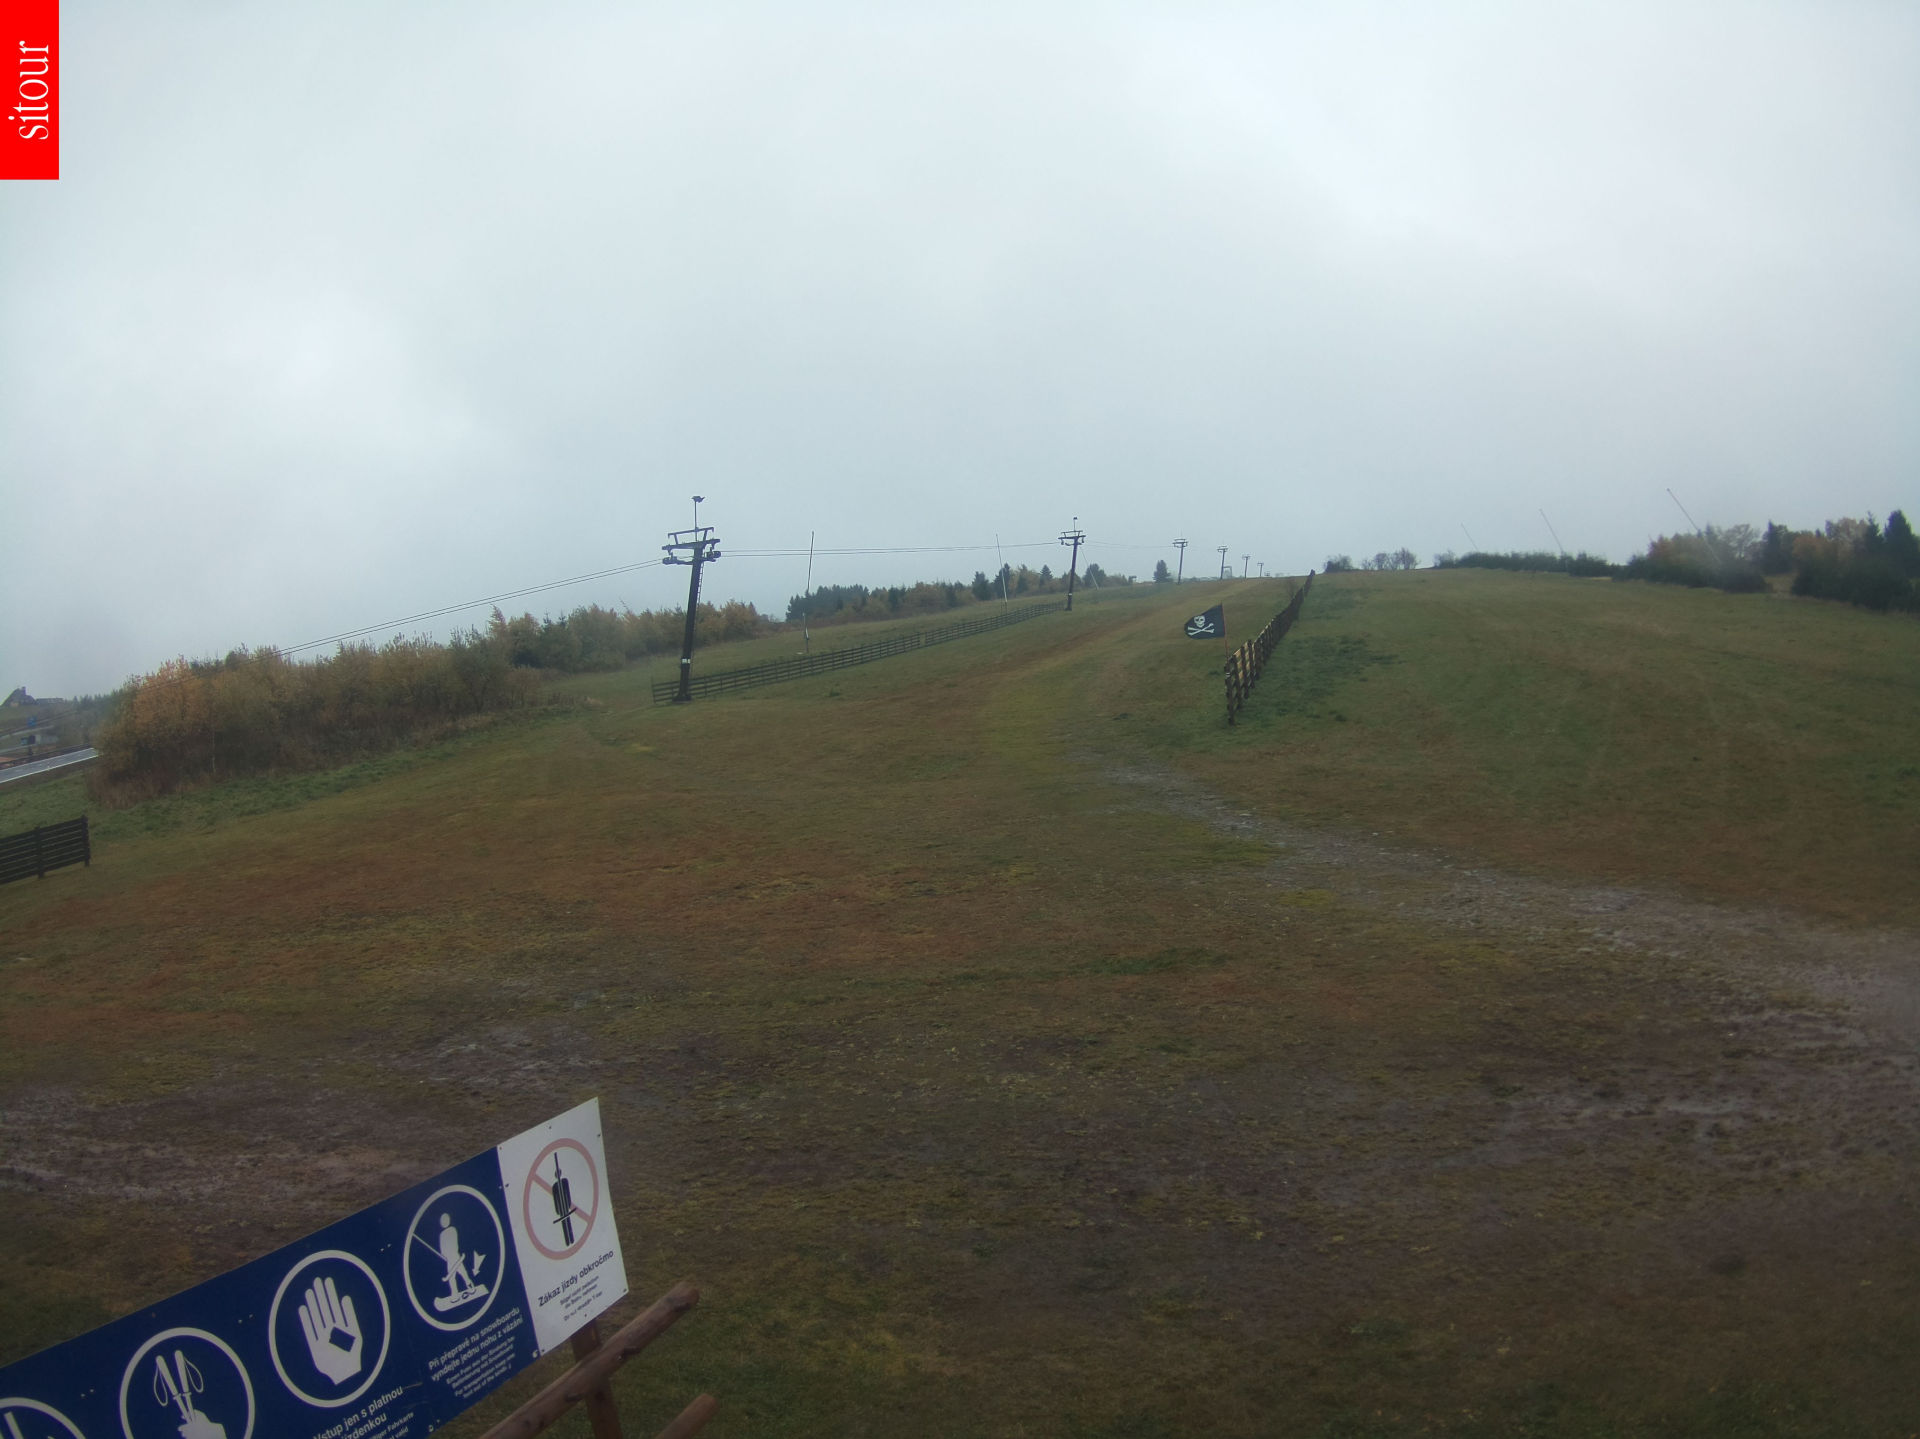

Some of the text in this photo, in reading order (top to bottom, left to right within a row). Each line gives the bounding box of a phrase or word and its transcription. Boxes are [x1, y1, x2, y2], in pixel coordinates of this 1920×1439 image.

[538, 1287, 561, 1307] Zákaz
[579, 1250, 614, 1278] obkročmo
[471, 1333, 480, 1343] na
[480, 1307, 519, 1336] snowboardu
[460, 1345, 480, 1364] jednu
[480, 1334, 497, 1349] nohu
[343, 1413, 360, 1431] jen
[361, 1409, 368, 1418] s
[368, 1386, 404, 1415] platnou
